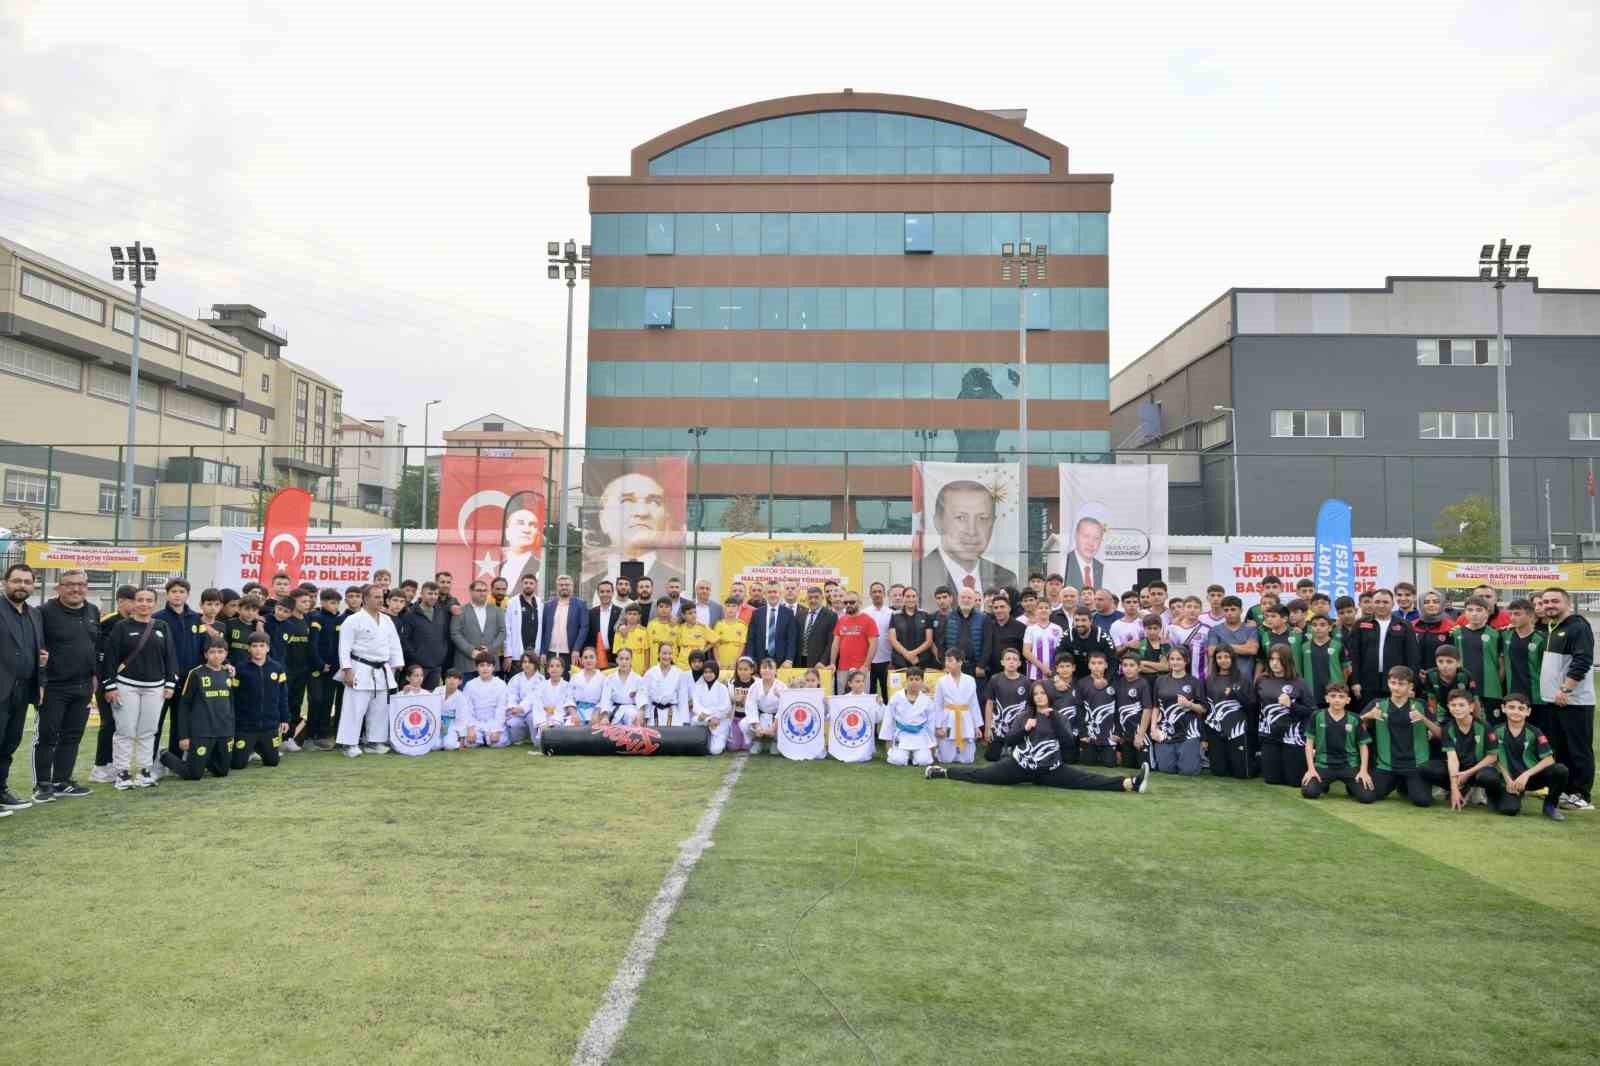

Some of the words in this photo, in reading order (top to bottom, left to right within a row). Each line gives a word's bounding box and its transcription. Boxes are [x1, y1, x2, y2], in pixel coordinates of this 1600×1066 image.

[319, 568, 369, 581] DİLERİZ
[1233, 564, 1263, 577] TÜM
[202, 676, 211, 687] 13
